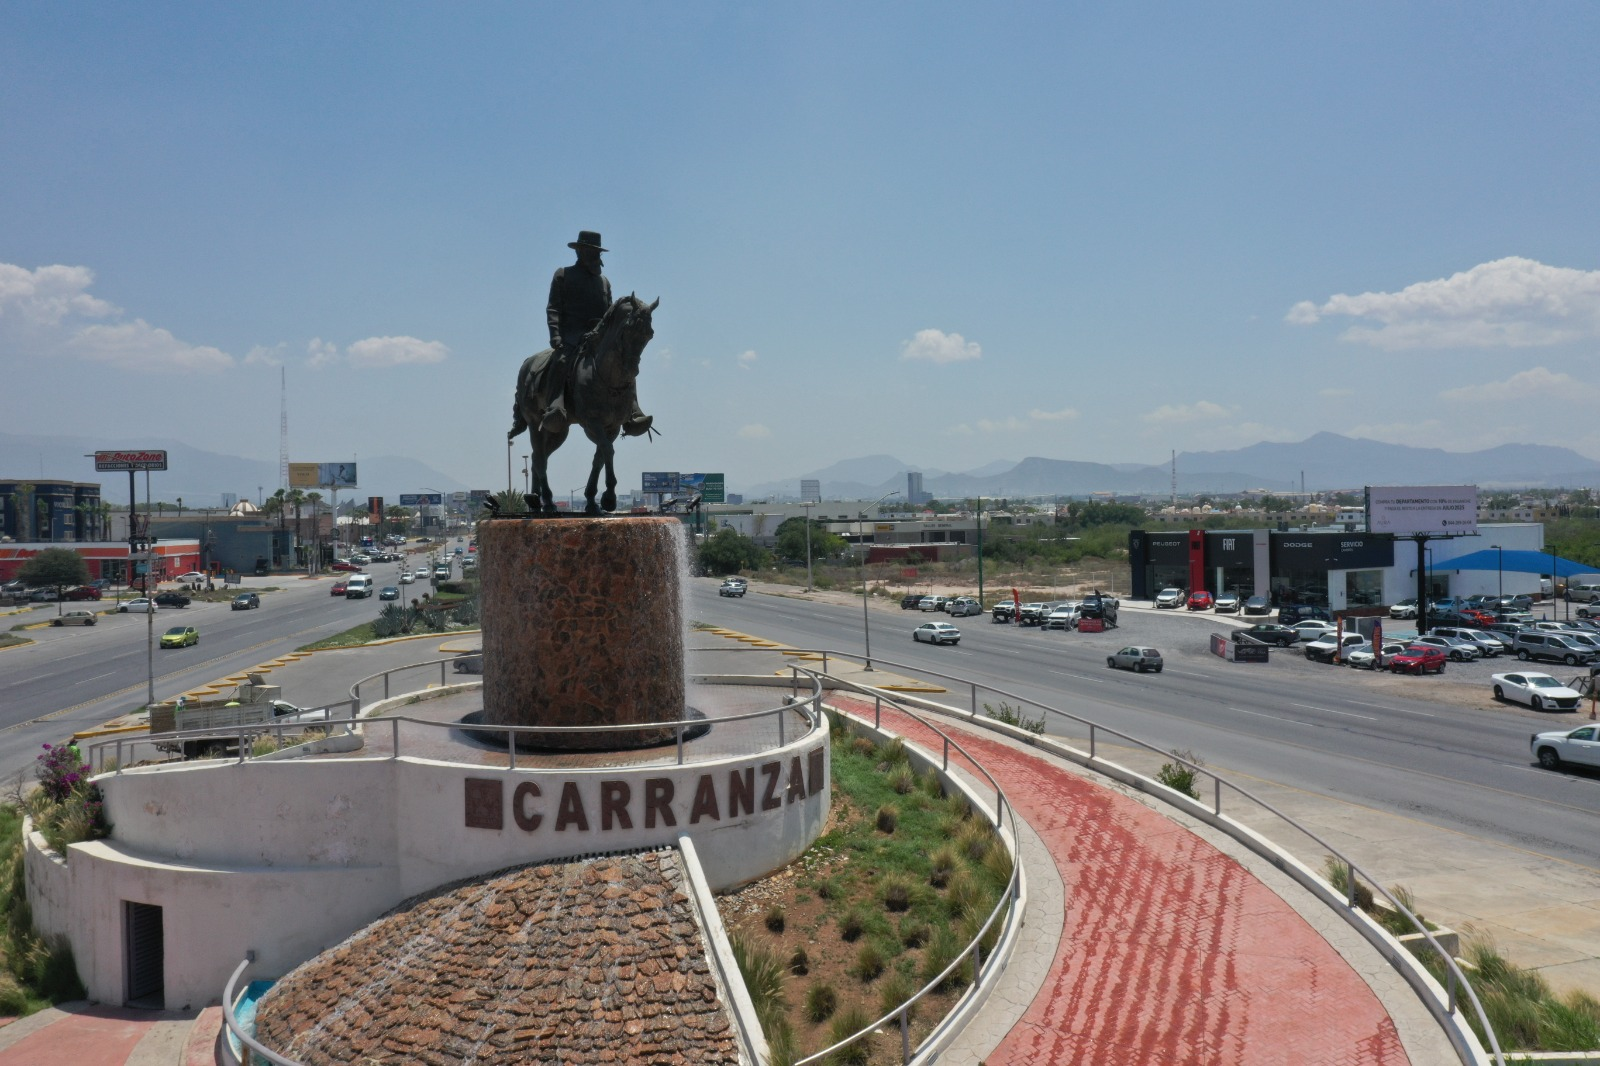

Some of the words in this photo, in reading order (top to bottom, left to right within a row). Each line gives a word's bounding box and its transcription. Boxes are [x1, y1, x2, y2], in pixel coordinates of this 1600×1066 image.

[112, 452, 163, 462] AutoZone
[1222, 538, 1236, 551] FIAT
[512, 756, 806, 832] CARRANZA
